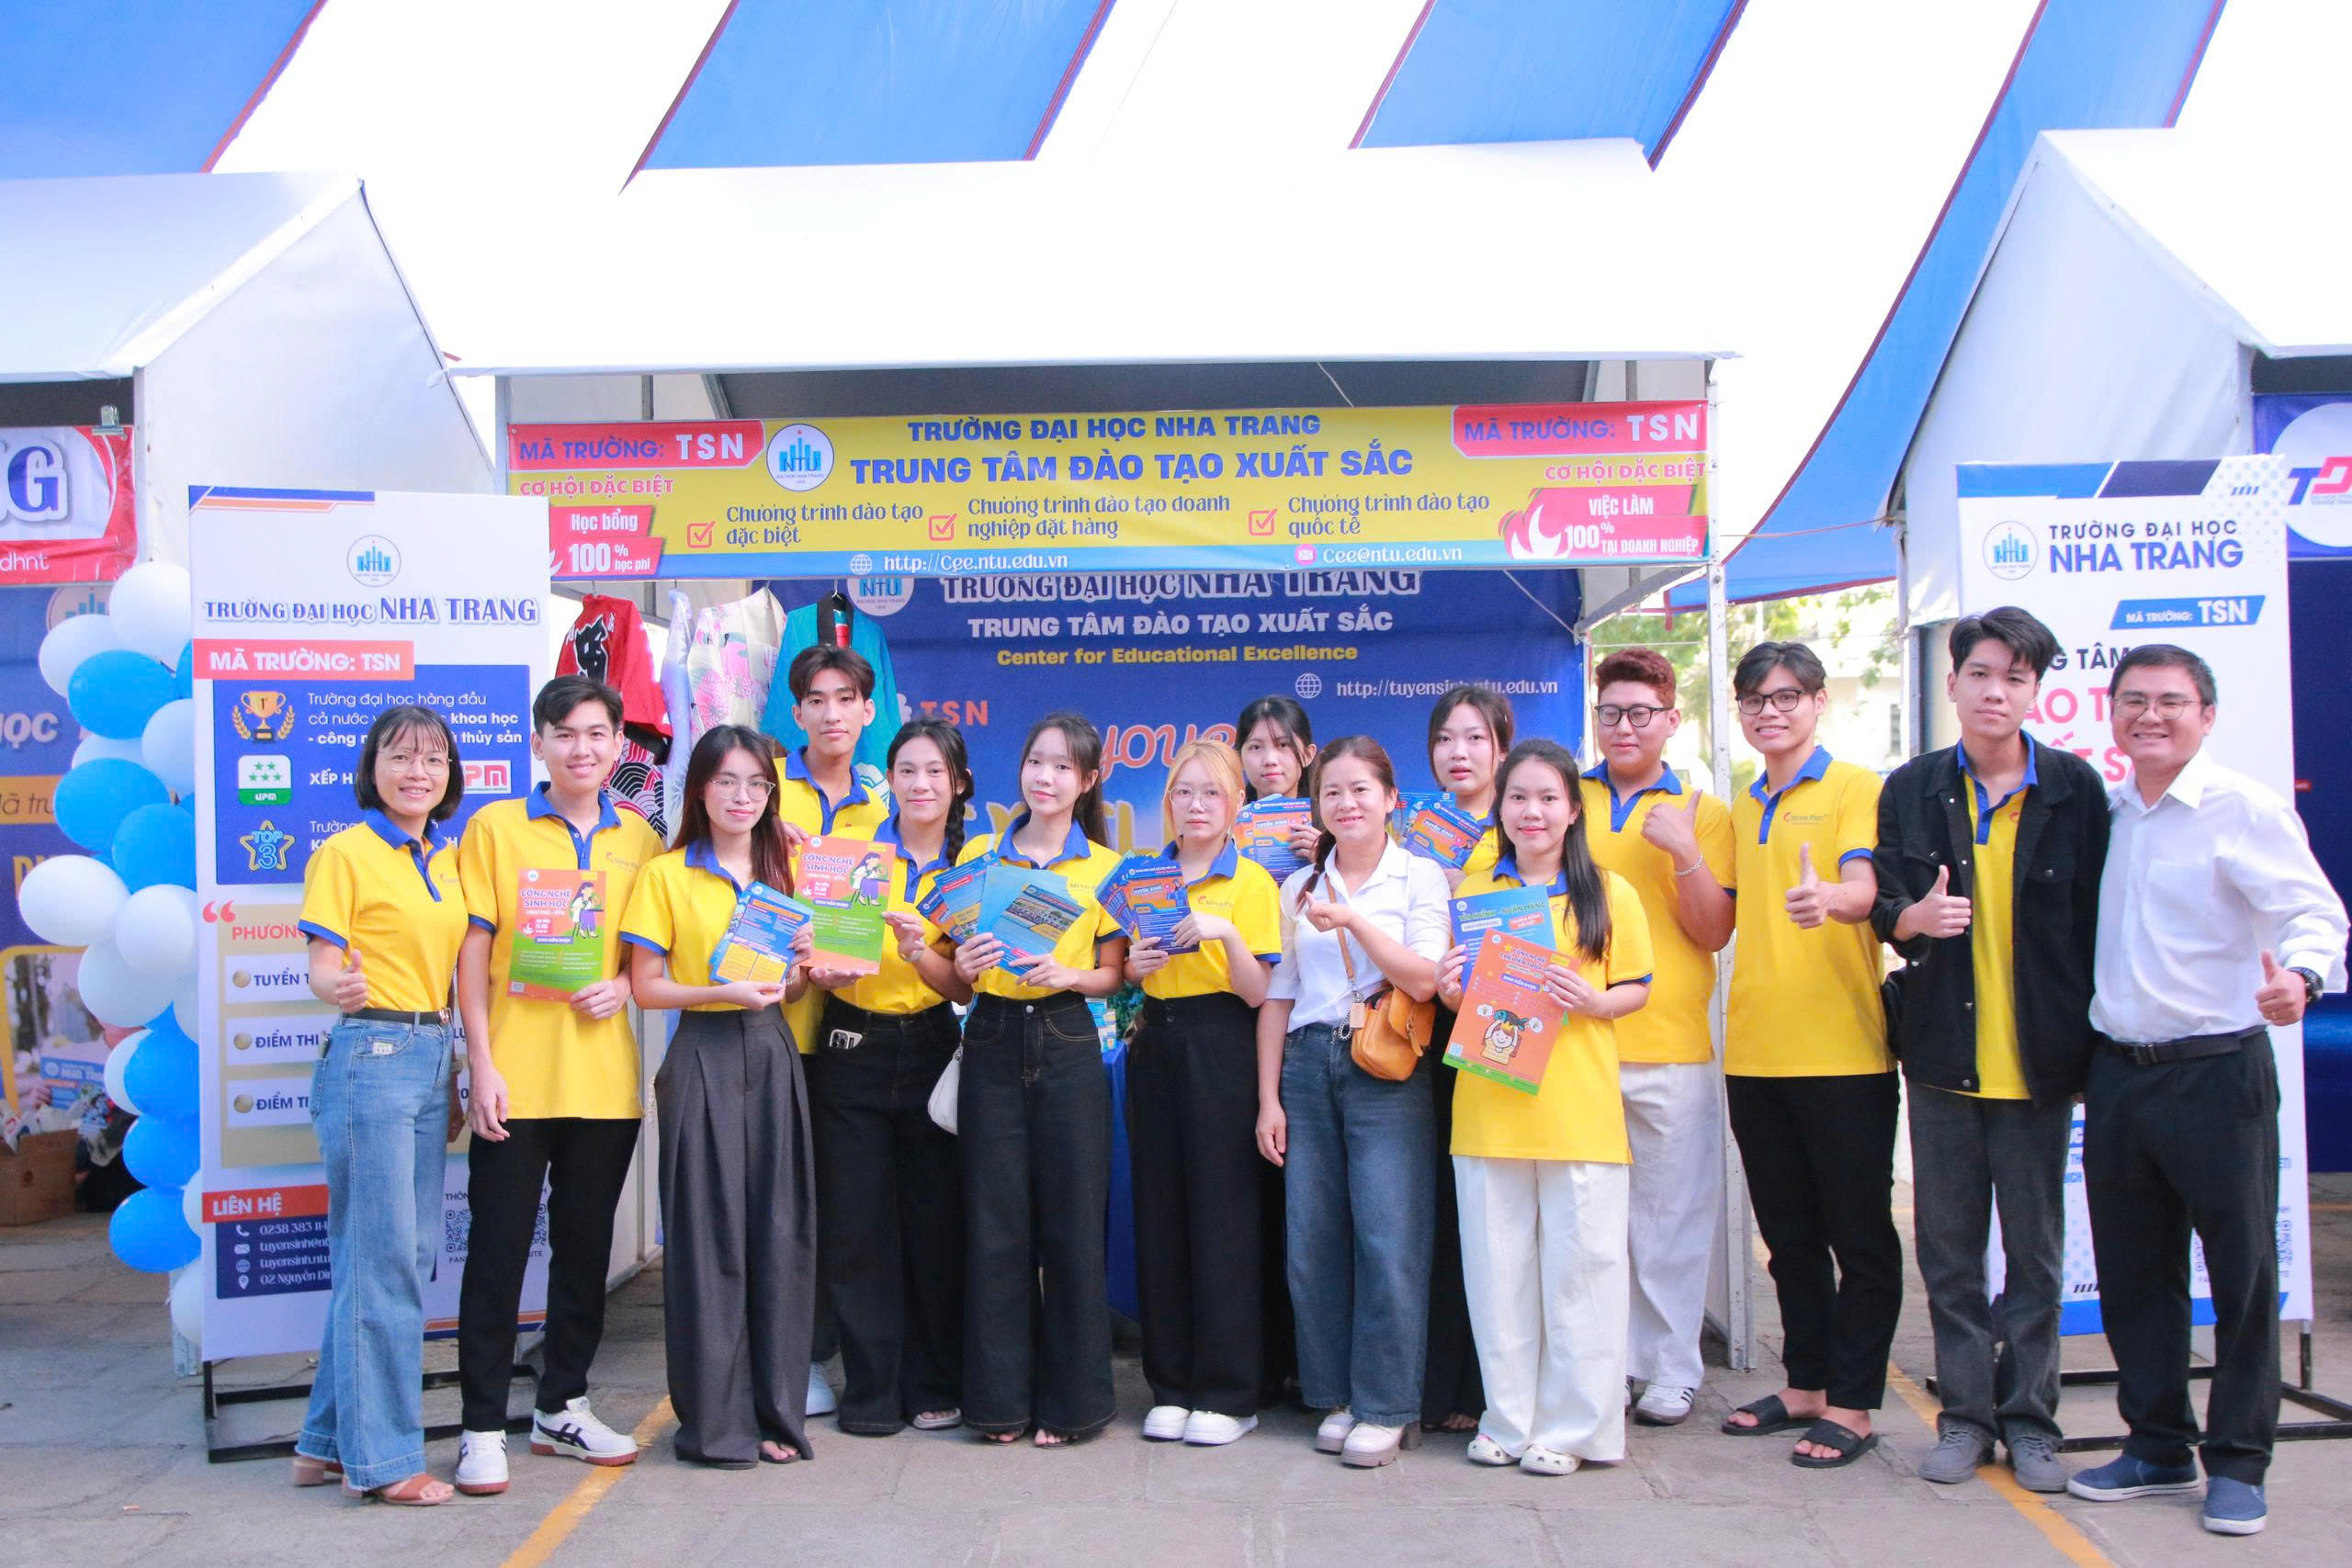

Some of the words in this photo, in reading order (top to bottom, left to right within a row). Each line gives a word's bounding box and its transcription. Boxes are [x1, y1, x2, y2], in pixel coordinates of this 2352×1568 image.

[908, 417, 1022, 441] TRƯỜNG
[1030, 419, 1078, 443] ĐẠI
[1088, 417, 1146, 442] HỌC
[1156, 417, 1216, 436] NHA
[1225, 414, 1320, 436] TRANG
[1464, 418, 1502, 441] MÃ
[1510, 416, 1616, 440] TRƯỜNG:
[1627, 414, 1698, 441] TSN
[520, 438, 555, 459] MÃ
[562, 435, 664, 459] TRƯỜNG:
[675, 434, 743, 460] TSN
[850, 458, 971, 484] TRUNG
[981, 450, 1056, 481] TÂM
[1069, 448, 1143, 480] ĐÀO
[1155, 453, 1224, 484] TẠO
[1235, 444, 1329, 478] XUẤT
[1340, 438, 1412, 476] SẮC
[1544, 463, 1573, 480] CƠ
[1577, 460, 1612, 483] HỘI
[1618, 458, 1657, 482] ĐẶC
[1664, 457, 1706, 481] BIỆT
[520, 480, 546, 495] CƠ
[550, 476, 585, 499] HỘI
[591, 475, 628, 498] ĐẶC
[632, 475, 673, 497] BIỆT
[727, 503, 796, 525] Chương
[801, 503, 847, 521] trình
[852, 502, 886, 520] đào
[892, 502, 923, 523] tạo
[968, 496, 1038, 516] Chương
[1044, 496, 1090, 513] trình
[1094, 494, 1129, 513] đào
[1135, 494, 1167, 515] tạo
[1171, 495, 1230, 512] doanh
[1288, 494, 1360, 515] Chương
[1365, 493, 1412, 512] trình
[1417, 493, 1452, 511] đào
[1457, 492, 1490, 513] tạo
[1589, 495, 1619, 519] VIỆC
[1623, 495, 1654, 515] LÀM
[571, 513, 598, 534] Học
[602, 508, 639, 531] bổng
[968, 519, 1031, 540] nghiệp
[1036, 520, 1068, 538] đặt
[1072, 517, 1118, 538] hàng
[1288, 513, 1334, 538] quốc
[2049, 521, 2135, 540] TRƯỜNG
[2146, 522, 2181, 541] ĐẠI
[2192, 520, 2237, 539] HỌC
[727, 528, 759, 547] đặc
[763, 525, 801, 547] biệt
[1565, 525, 1600, 549] 100
[1601, 539, 1618, 555] TẠI
[1621, 539, 1657, 553] DOANH
[1660, 536, 1699, 555] NGHIỆP
[569, 543, 611, 572] 100
[615, 559, 633, 572] học
[2050, 544, 2123, 573] NHA
[2131, 538, 2244, 570] TRANG
[205, 599, 286, 619] TRƯỜNG
[293, 603, 325, 622] ĐẠI
[333, 604, 373, 623] HỌC
[380, 597, 435, 620] NHA
[447, 598, 536, 621] TRANG
[968, 617, 1059, 637] TRUNG
[1068, 612, 1125, 636] TÂM
[1134, 610, 1190, 635] ĐÀO
[1198, 615, 1250, 637] TẠO
[1259, 607, 1329, 633] XUẤT
[1338, 604, 1393, 632] SẮC
[2198, 600, 2248, 625] TSN
[209, 649, 248, 671] MÃ
[254, 649, 356, 671] TRƯỜNG:
[362, 653, 400, 671] TSN
[997, 649, 1068, 665] Center
[1074, 648, 1105, 664] for
[1113, 646, 1237, 663] Educational
[1244, 645, 1358, 661] Excellence
[309, 693, 356, 707] Trường
[359, 693, 383, 707] đại
[419, 693, 455, 707] hàng
[458, 692, 486, 705] đầu
[309, 713, 328, 725] cả
[332, 713, 368, 725] nước
[451, 712, 487, 724] khoa
[492, 712, 519, 728] học
[921, 700, 989, 726] TSN
[0, 713, 59, 749] ỌC
[318, 733, 356, 747] công
[462, 731, 493, 746] thủy
[497, 732, 523, 744] sản
[310, 768, 338, 784] XẾP
[465, 765, 507, 786] PM
[252, 830, 284, 844] TOP
[258, 843, 277, 870] 3
[254, 967, 300, 986] TUYỂN
[255, 1029, 292, 1048] ĐIỂM
[297, 1034, 319, 1046] THI
[256, 1091, 293, 1111] ĐIỂM
[213, 1195, 253, 1216] LIÊN
[257, 1191, 282, 1216] HỆ
[260, 1274, 276, 1285] 02
